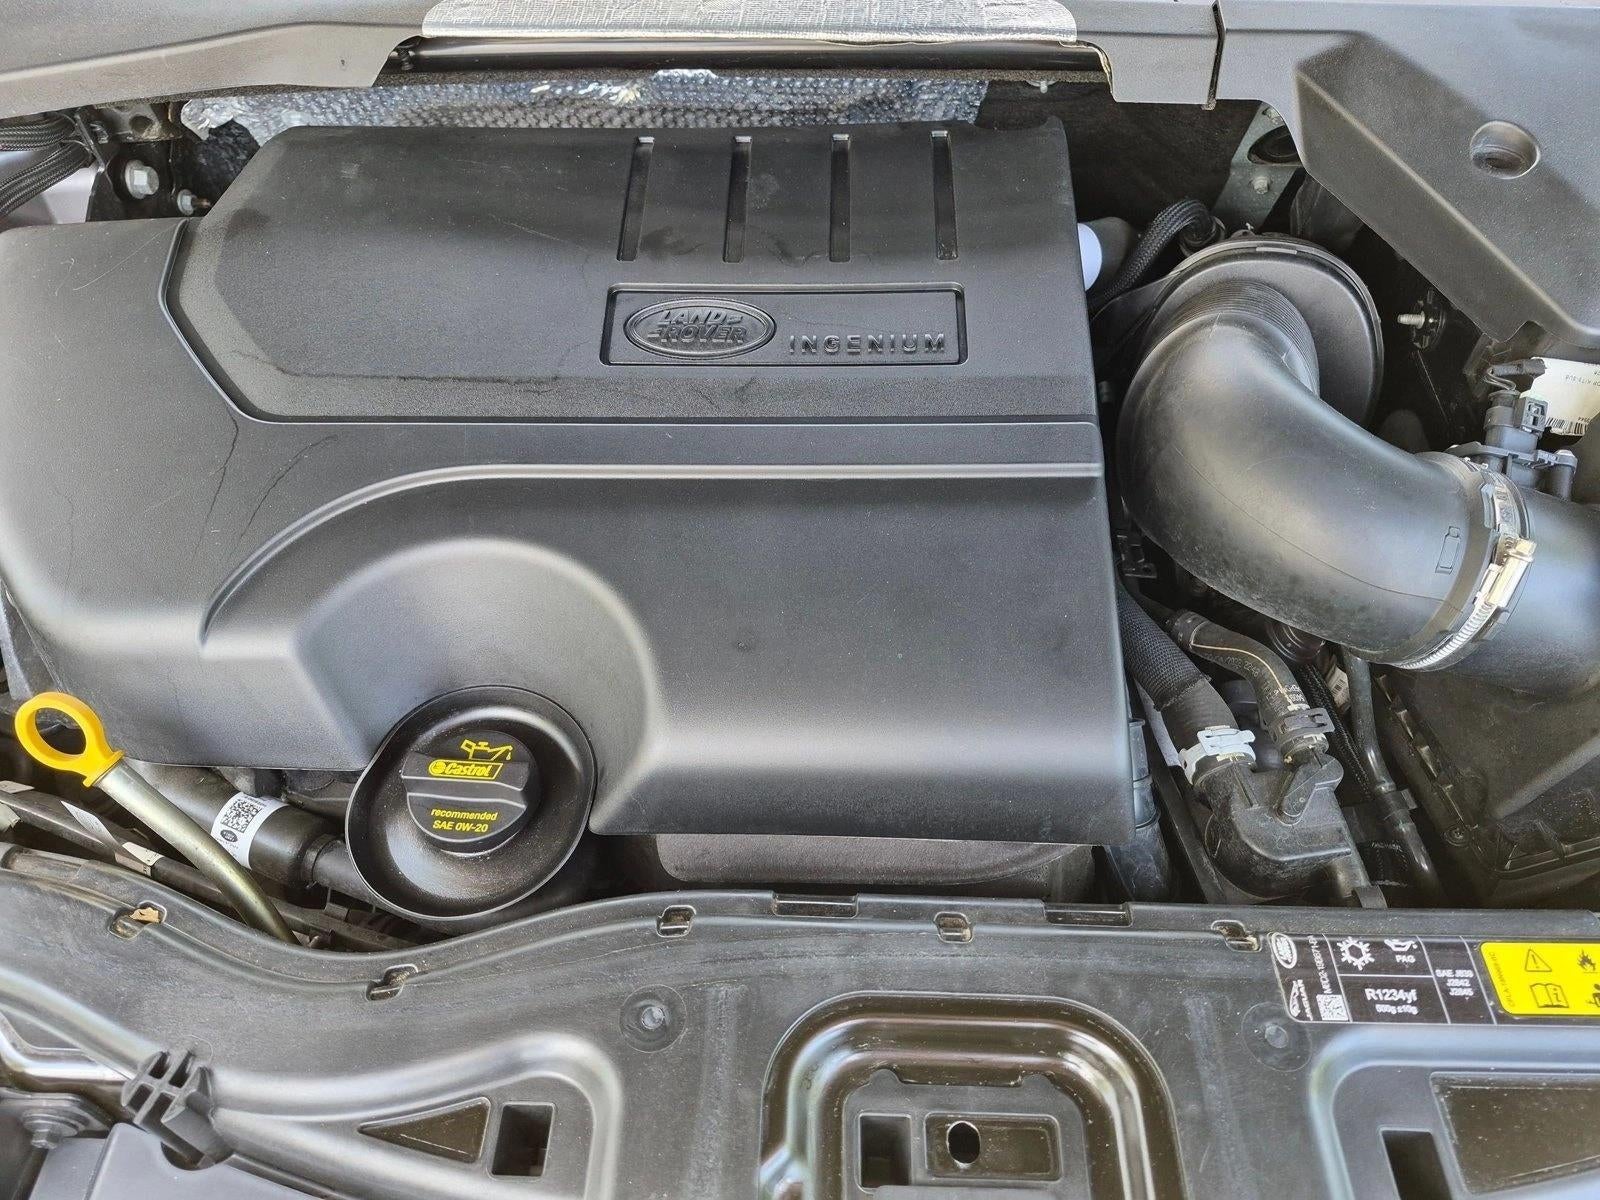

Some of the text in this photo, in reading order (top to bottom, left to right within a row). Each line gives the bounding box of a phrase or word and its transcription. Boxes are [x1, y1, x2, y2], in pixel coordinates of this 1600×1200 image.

[656, 309, 744, 326] LAND
[648, 324, 748, 344] ROVER
[789, 333, 946, 355] INGENIUM
[445, 762, 493, 777] Castrol
[431, 808, 498, 821] recommended
[432, 820, 489, 833] SAE 0W-20
[1395, 954, 1417, 964] PAG
[1435, 969, 1454, 978] SAE
[1364, 988, 1418, 1004] R1234yf
